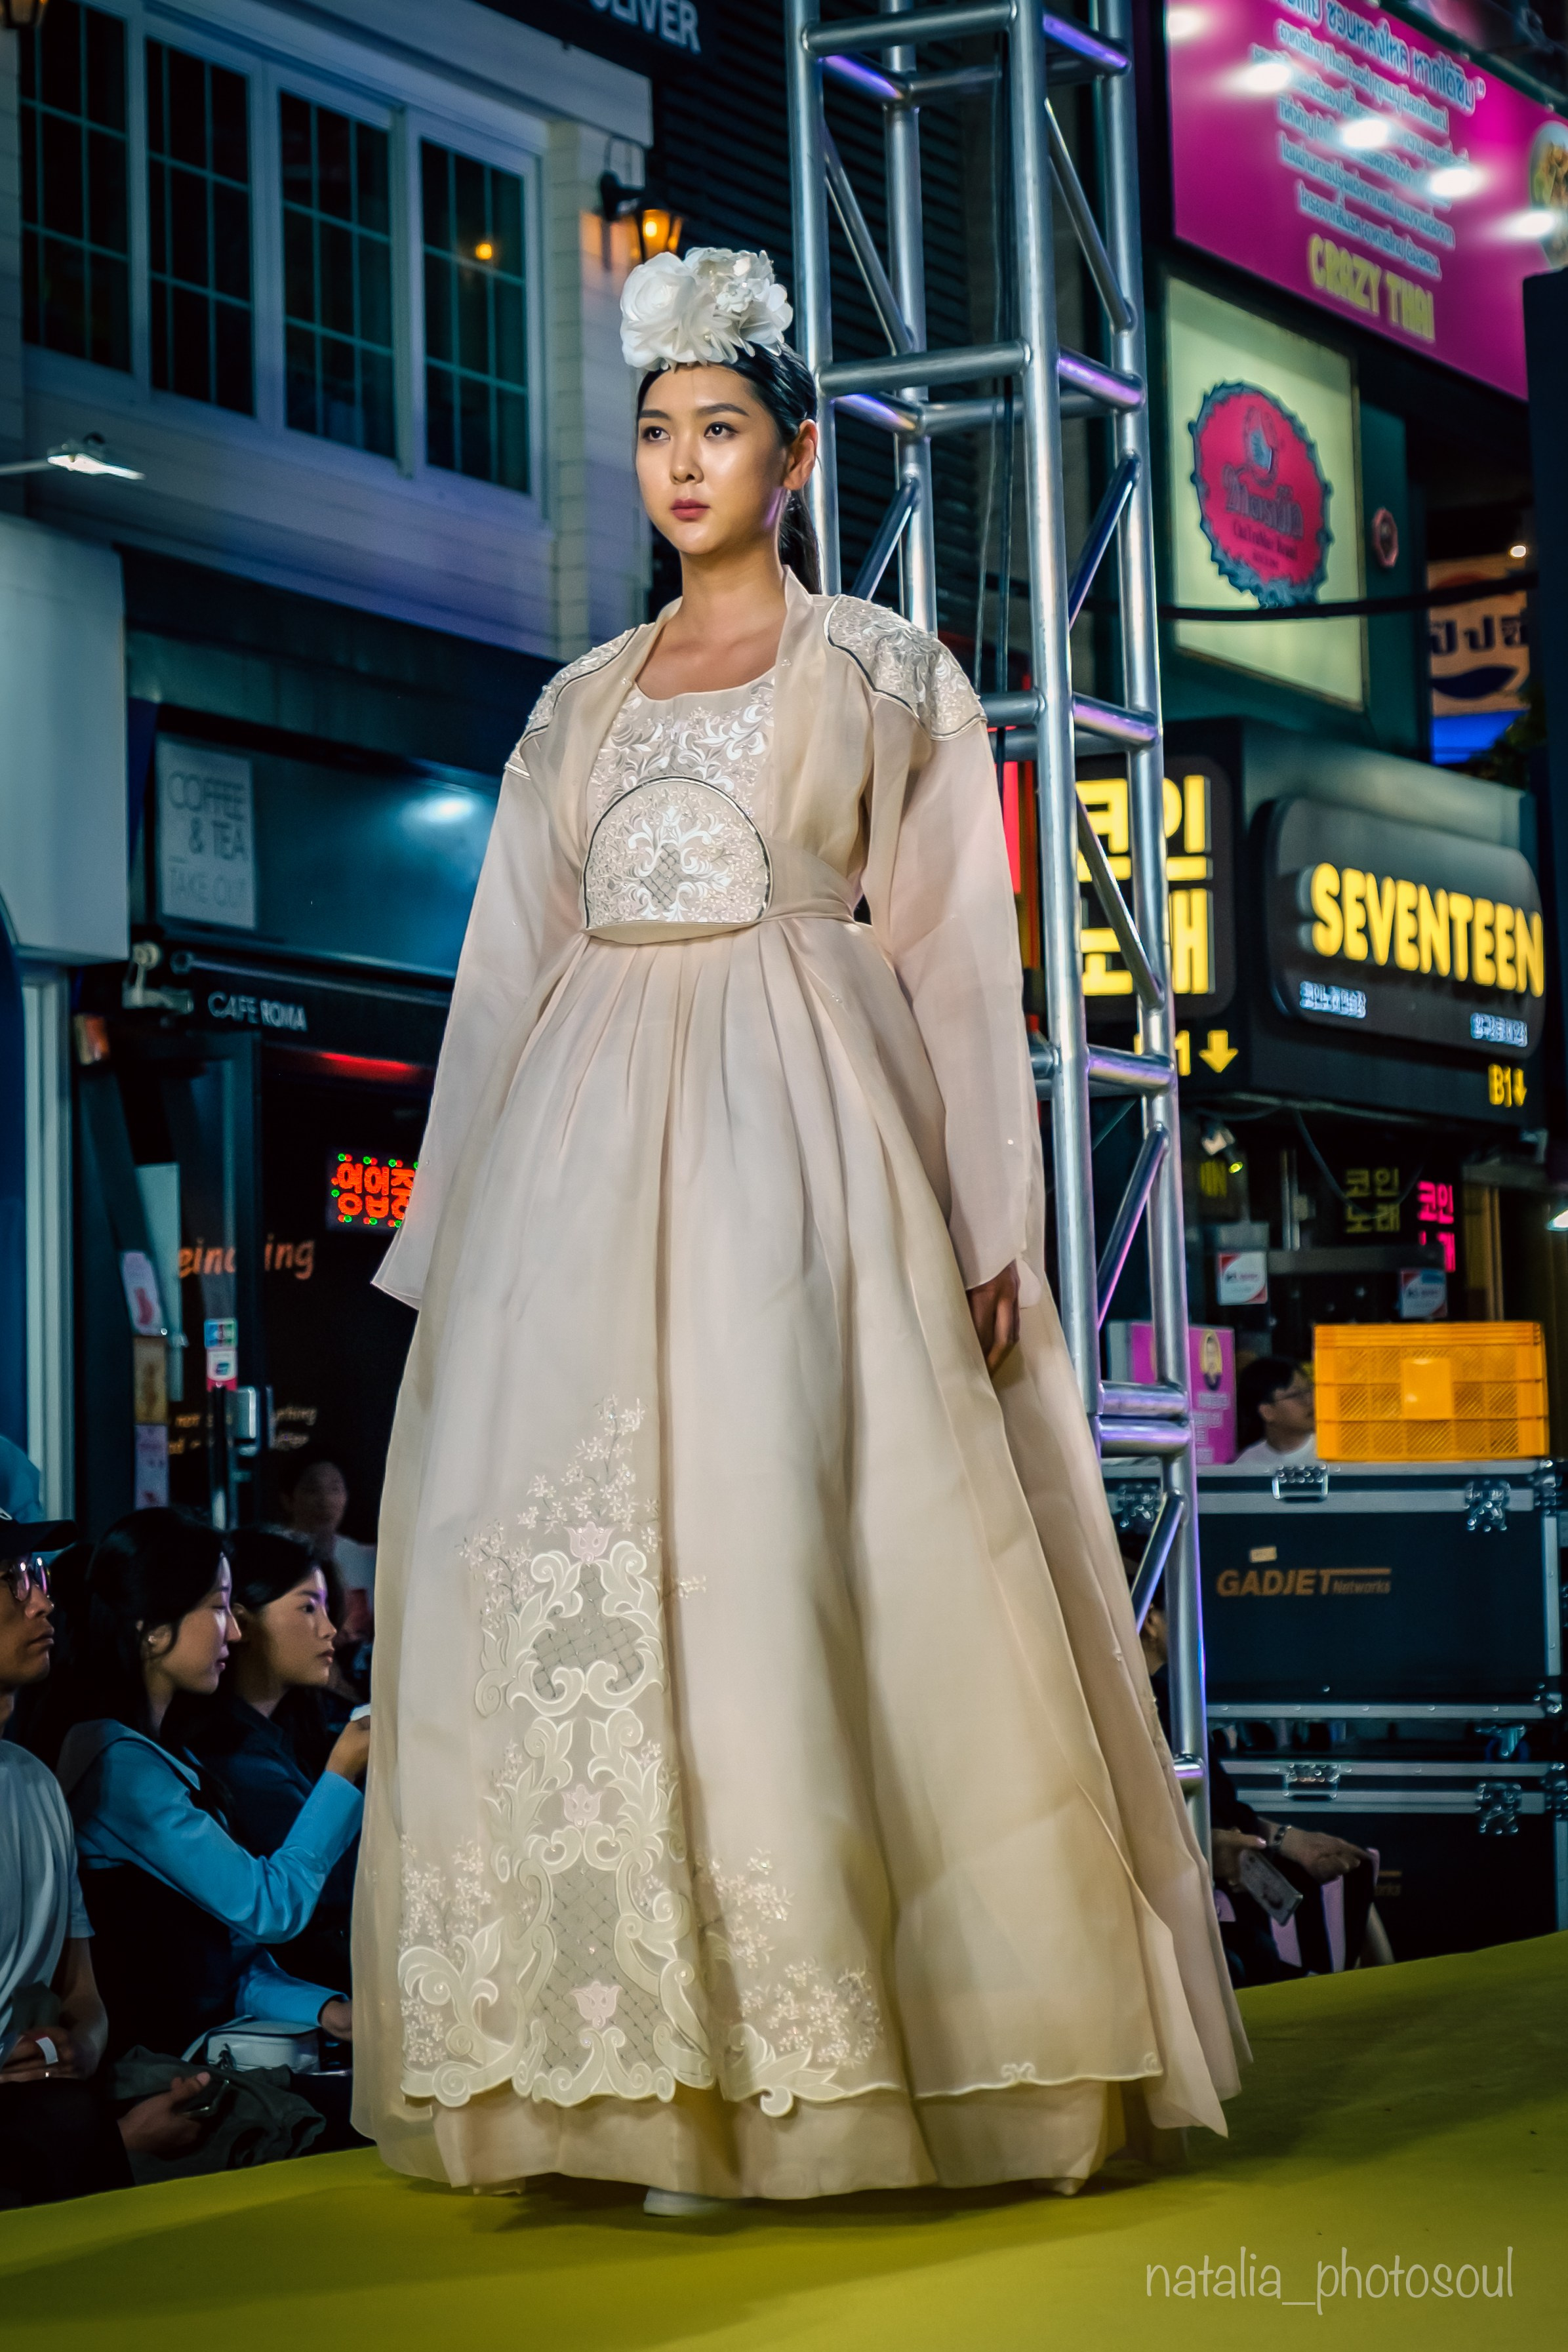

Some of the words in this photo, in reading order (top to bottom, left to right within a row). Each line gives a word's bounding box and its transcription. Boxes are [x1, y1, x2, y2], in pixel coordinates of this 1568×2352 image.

[1308, 233, 1380, 317] CRAZY
[167, 771, 245, 820] COFFEE
[211, 819, 248, 861] TEA
[1312, 861, 1544, 998] SEVENTEEN
[207, 990, 260, 1024] CAFE
[260, 998, 309, 1034] ROMA
[1488, 1063, 1512, 1107] B1
[1344, 1166, 1401, 1198] 코인
[1417, 1180, 1455, 1225] 코인
[1216, 1567, 1333, 1596] GADJET
